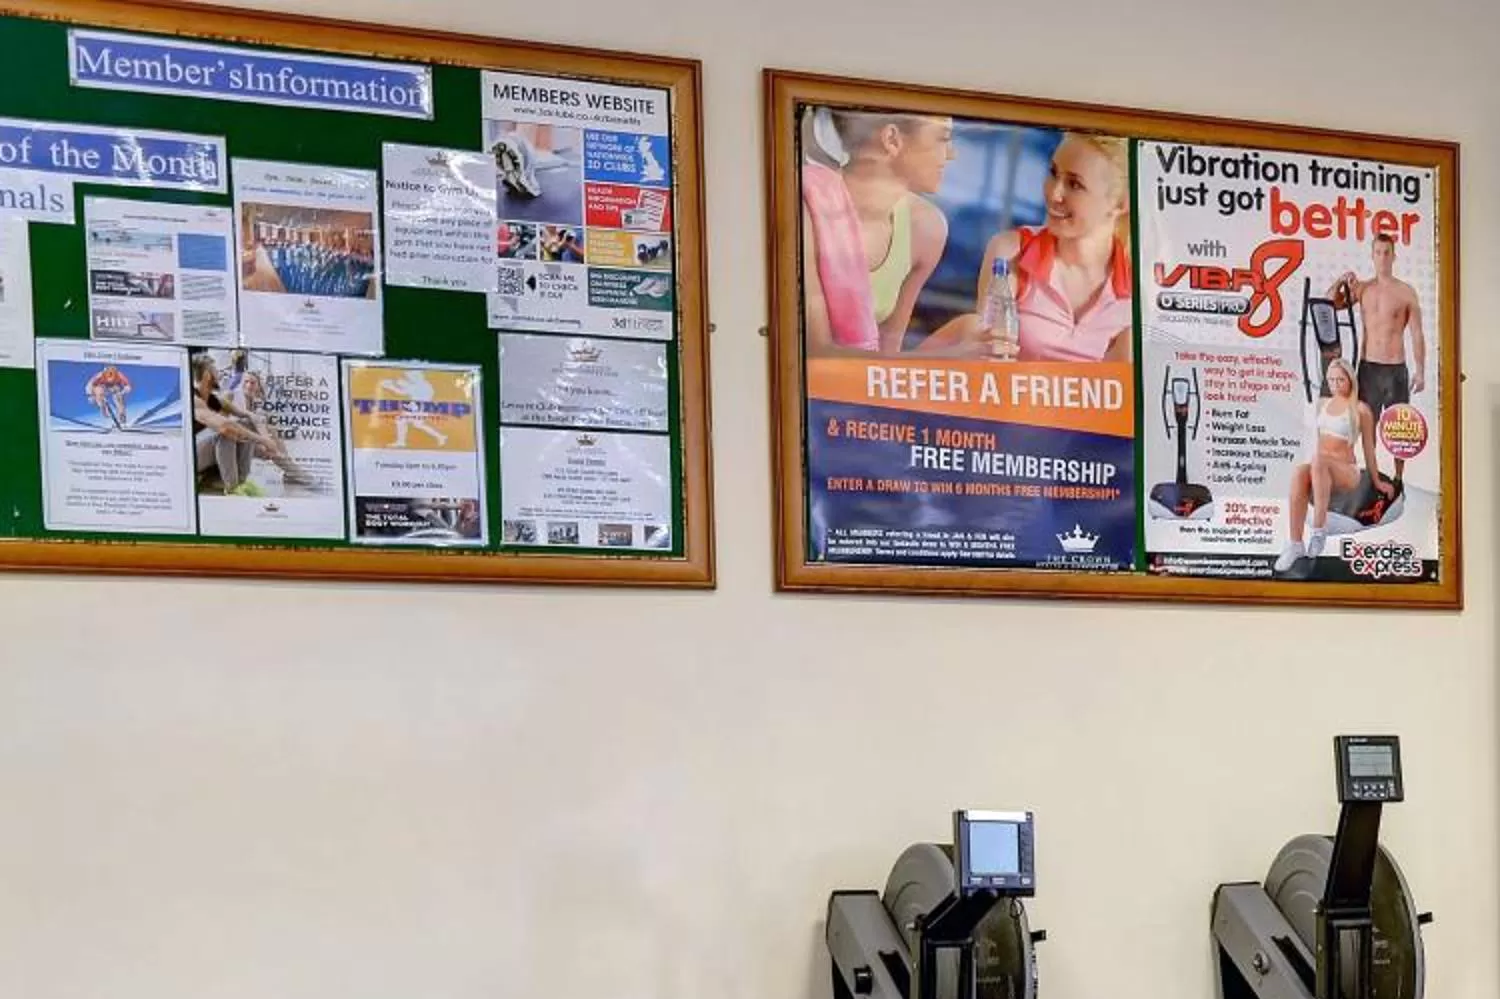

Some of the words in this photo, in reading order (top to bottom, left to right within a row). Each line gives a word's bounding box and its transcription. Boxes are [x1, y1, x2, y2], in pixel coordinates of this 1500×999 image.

[492, 83, 581, 107] MEMBERS
[585, 93, 656, 115] WEBSITE
[0, 135, 32, 164] of
[50, 139, 101, 169] the
[112, 143, 218, 180] Month
[1155, 145, 1299, 184] Vibration
[1309, 159, 1421, 203] training
[386, 180, 421, 191] Notice
[1157, 177, 1209, 211] just
[1218, 187, 1265, 215] got
[1269, 186, 1421, 246] better
[1187, 239, 1228, 258] with
[1242, 354, 1282, 366] effective
[866, 364, 970, 404] REFER
[979, 372, 1001, 405] A
[1010, 374, 1124, 411] FRIEND
[289, 402, 331, 415] YOUR
[1235, 409, 1250, 419] Fat
[1397, 407, 1411, 421] 10
[268, 417, 331, 428] CHANCE
[1211, 421, 1245, 433] Weight
[1383, 420, 1424, 432] MINUTE
[301, 430, 332, 441] WIN
[827, 417, 840, 438] &
[845, 420, 917, 444] RECEIVE
[922, 427, 930, 446] 1
[935, 428, 996, 451] MONTH
[910, 445, 965, 472] FREE
[971, 450, 1117, 487] MEMBERSHIP
[1211, 473, 1234, 483] Look
[827, 477, 863, 492] ENTER
[877, 479, 912, 493] DRAW
[931, 482, 953, 495] WIN
[965, 482, 1011, 497] MONTHS
[1014, 483, 1041, 497] FREE
[1224, 502, 1248, 513] 20%
[1249, 504, 1280, 514] more
[1225, 517, 1273, 527] effective
[1342, 541, 1414, 561] Exercise
[1353, 559, 1422, 576] express
